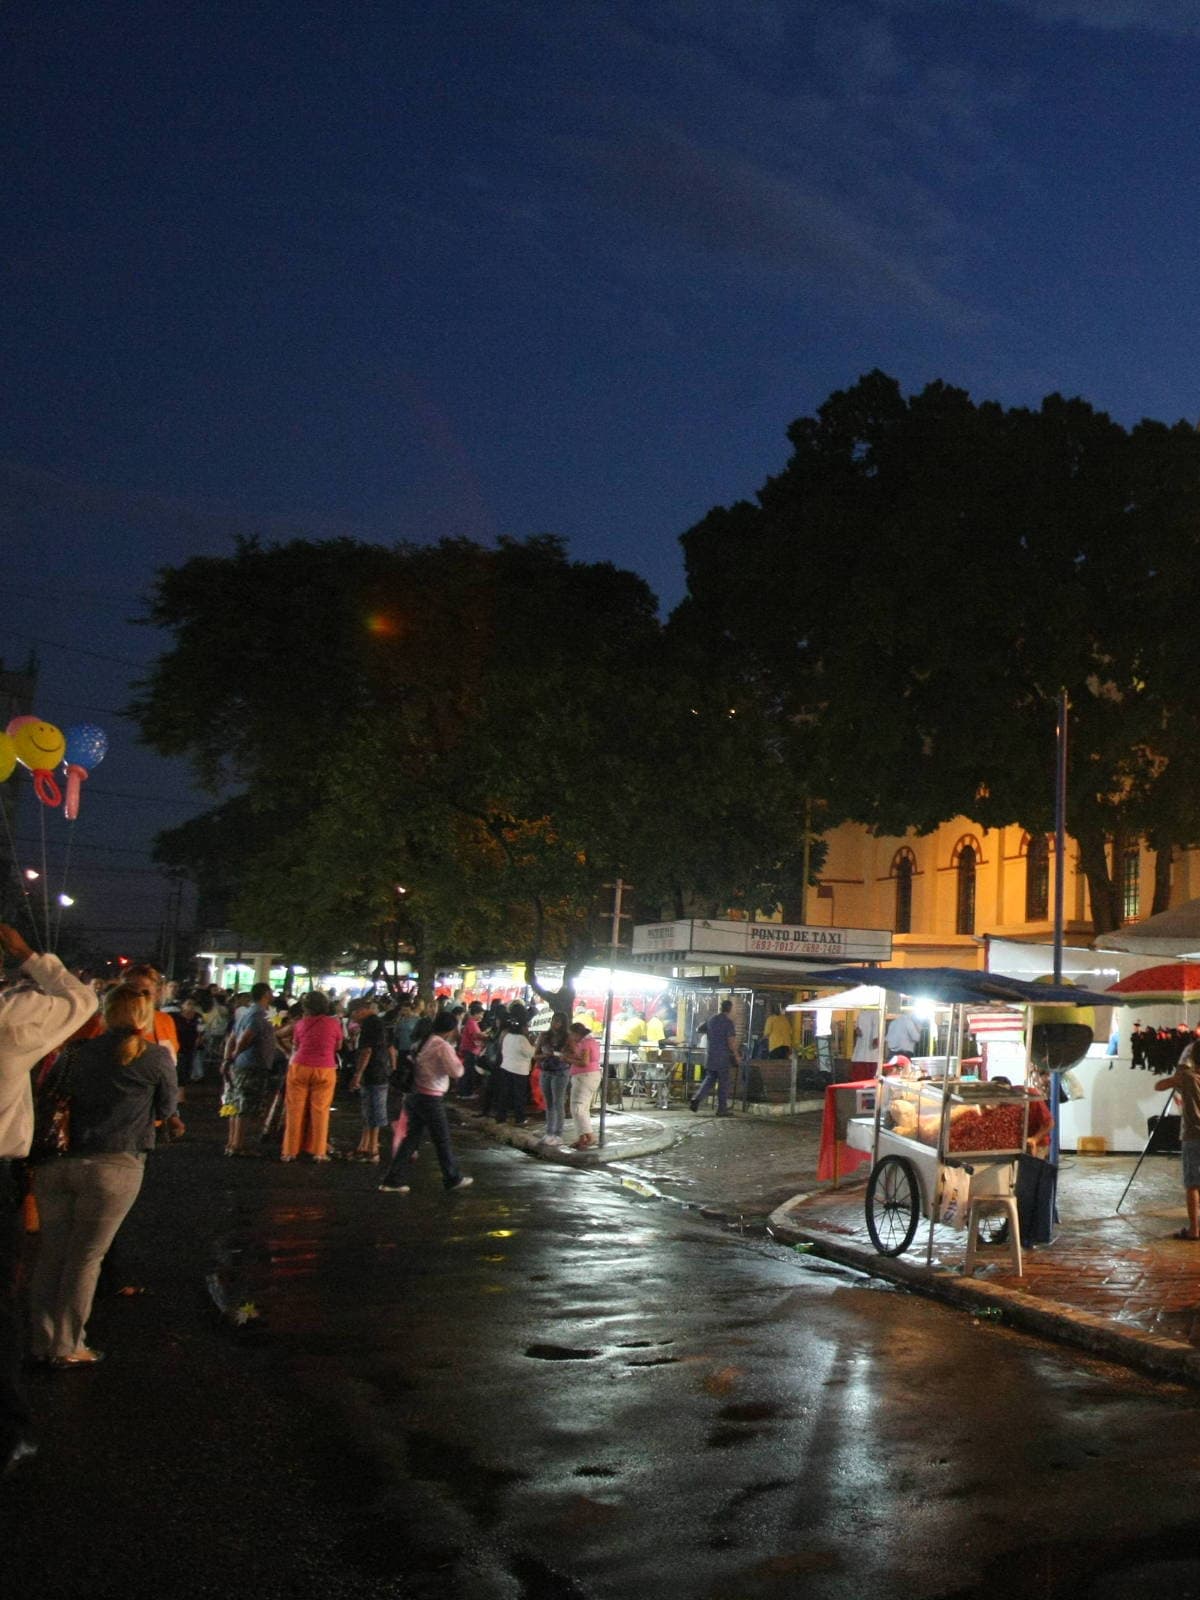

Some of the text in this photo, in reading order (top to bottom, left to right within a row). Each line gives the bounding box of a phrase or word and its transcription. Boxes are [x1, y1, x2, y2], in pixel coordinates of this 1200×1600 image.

[751, 928, 842, 944] PONTO DE TAXI
